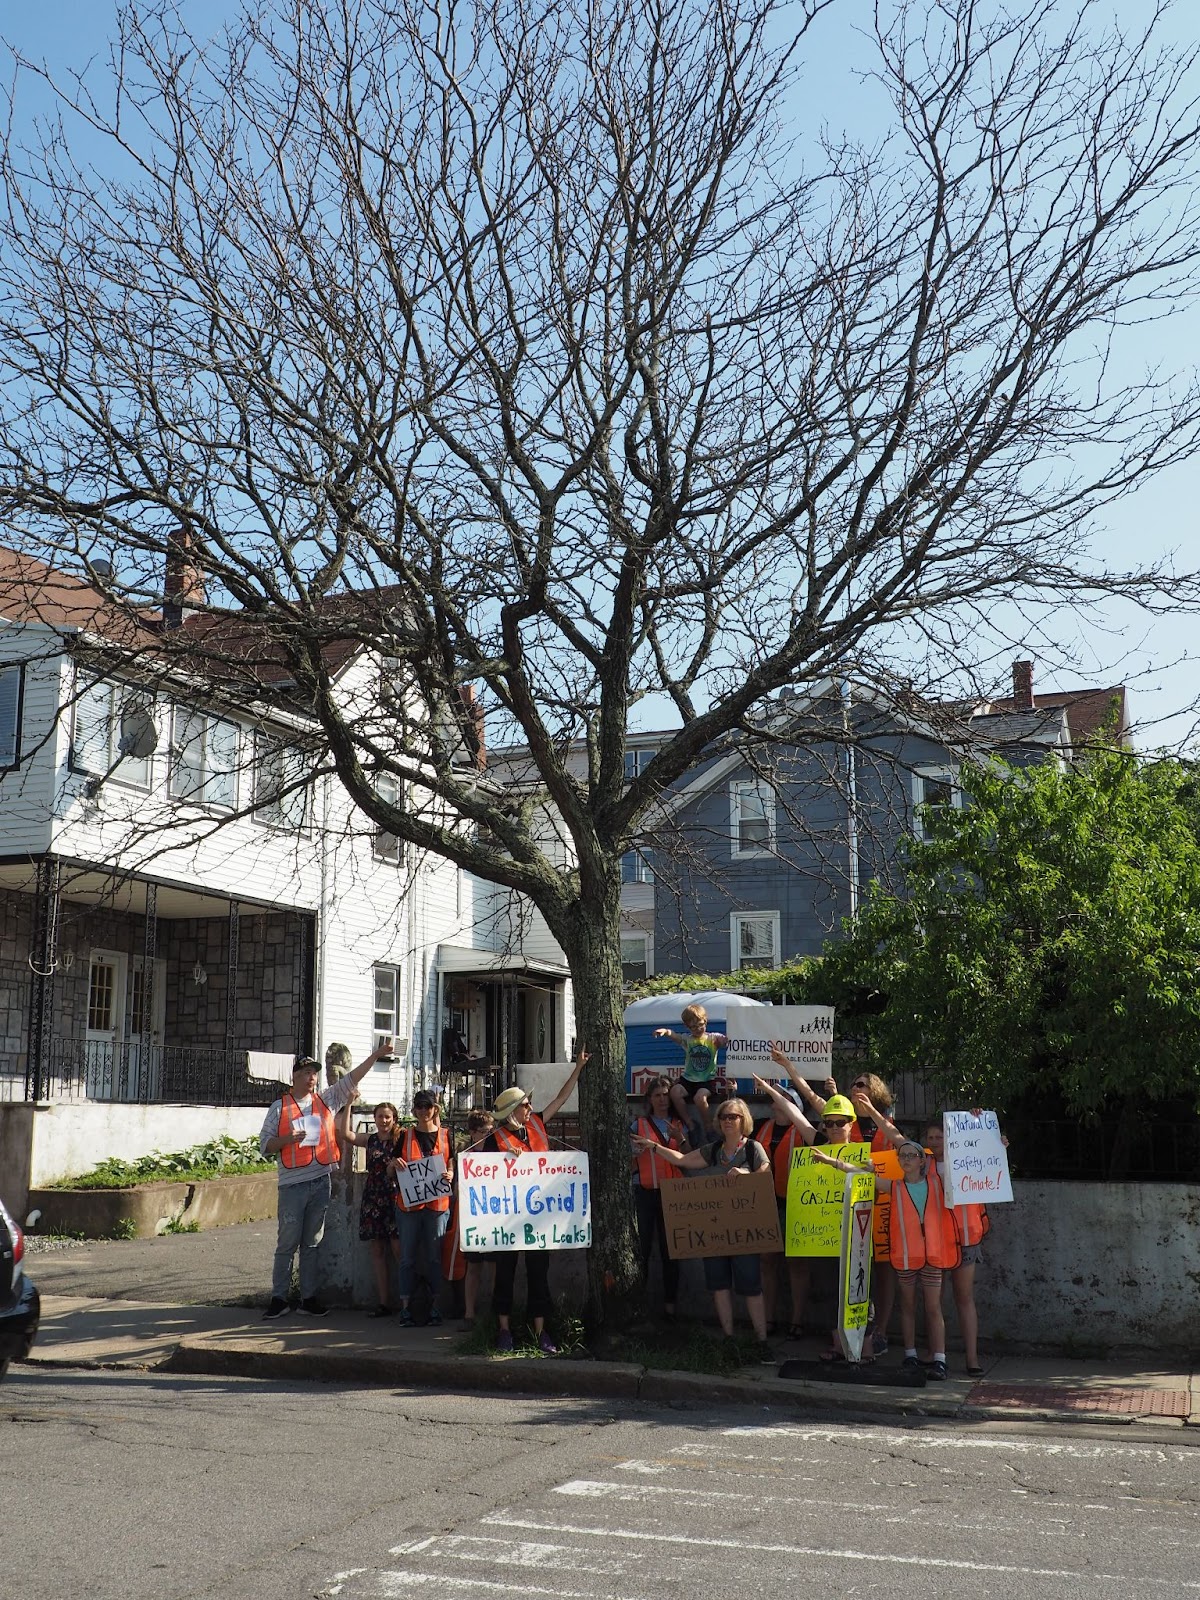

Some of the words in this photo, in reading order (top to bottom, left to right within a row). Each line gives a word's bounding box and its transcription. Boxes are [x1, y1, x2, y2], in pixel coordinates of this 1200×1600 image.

[776, 1040, 796, 1053] OUT
[953, 1113, 983, 1134] Natural
[963, 1138, 980, 1148] our
[407, 1159, 433, 1178] FIX
[462, 1158, 499, 1180] Keep
[503, 1158, 534, 1179] Your
[796, 1175, 811, 1187] Fix
[817, 1174, 827, 1186] the
[857, 1177, 873, 1188] STATE
[961, 1170, 1002, 1192] Climate!
[405, 1178, 451, 1204] LEAKS
[668, 1200, 724, 1212] MEASURE
[731, 1191, 756, 1209] UP!
[821, 1206, 830, 1217] for
[465, 1226, 487, 1247] Fix
[491, 1226, 516, 1246] the
[523, 1223, 547, 1249] Big
[552, 1222, 591, 1247] Leaks!
[711, 1232, 725, 1242] the
[726, 1223, 779, 1246] LEAKS!
[794, 1221, 835, 1235] Children's
